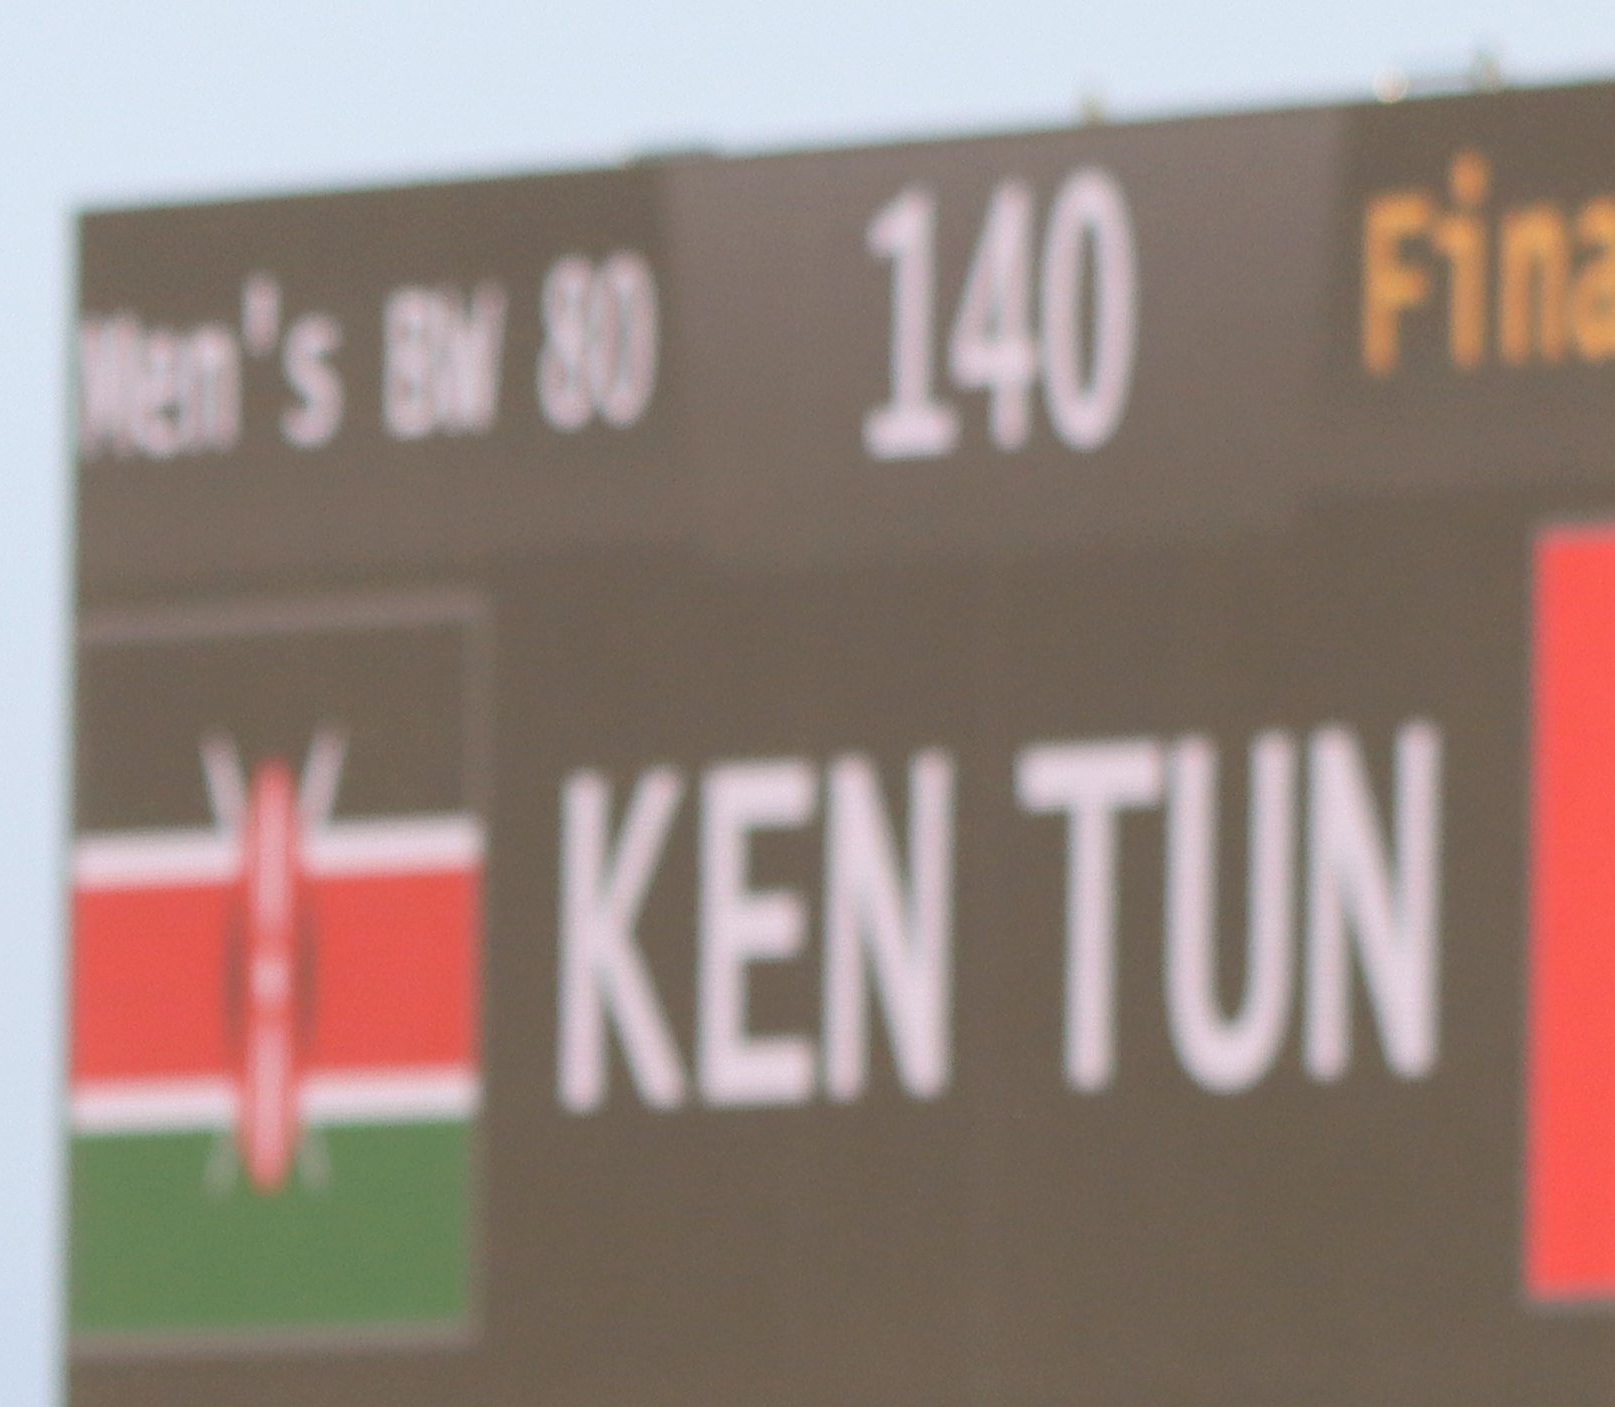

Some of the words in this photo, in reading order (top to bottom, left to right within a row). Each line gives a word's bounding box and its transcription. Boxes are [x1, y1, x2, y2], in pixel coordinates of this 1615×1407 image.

[78, 278, 344, 460] Men's
[384, 286, 506, 440] BW
[538, 253, 657, 432] 80
[860, 165, 1137, 460] 140
[1362, 152, 1615, 373] Fina
[557, 750, 954, 1113] KEN
[1014, 722, 1442, 1093] TUN
